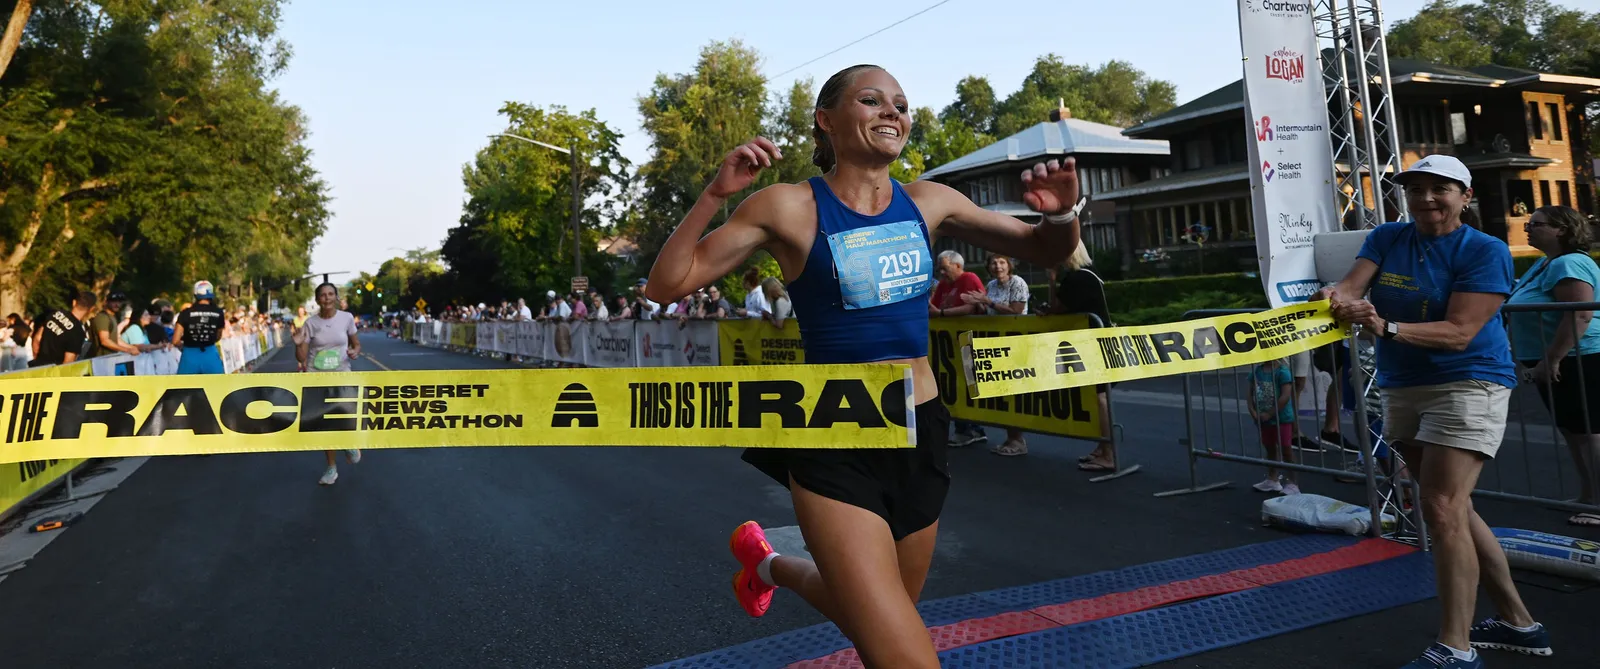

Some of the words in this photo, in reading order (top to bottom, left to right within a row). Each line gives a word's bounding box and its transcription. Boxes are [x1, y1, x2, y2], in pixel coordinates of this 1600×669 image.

[1263, 0, 1310, 14] Chartway
[1265, 54, 1304, 82] LOGAN
[1276, 124, 1322, 132] Intermountain
[1277, 162, 1302, 170] Select
[1278, 170, 1301, 179] Health
[1279, 213, 1313, 232] Minky
[866, 235, 908, 246] MARATHON
[878, 250, 920, 279] 2197
[53, 311, 74, 330] SOUND
[1257, 309, 1318, 329] DESERET
[1262, 323, 1297, 338] NEWS
[1268, 321, 1339, 348] MARATHON
[761, 350, 797, 361] NEWS
[1096, 337, 1126, 369] THIS
[1119, 335, 1139, 366] IS
[1131, 334, 1158, 365] THE
[363, 384, 490, 399] DESERET
[362, 400, 448, 414] NEWS
[628, 382, 671, 429] THIS
[674, 382, 695, 428] IS
[698, 382, 733, 428] THE
[5, 391, 54, 443] THE
[50, 385, 359, 440] RACE
[361, 414, 523, 430] MARATHON
